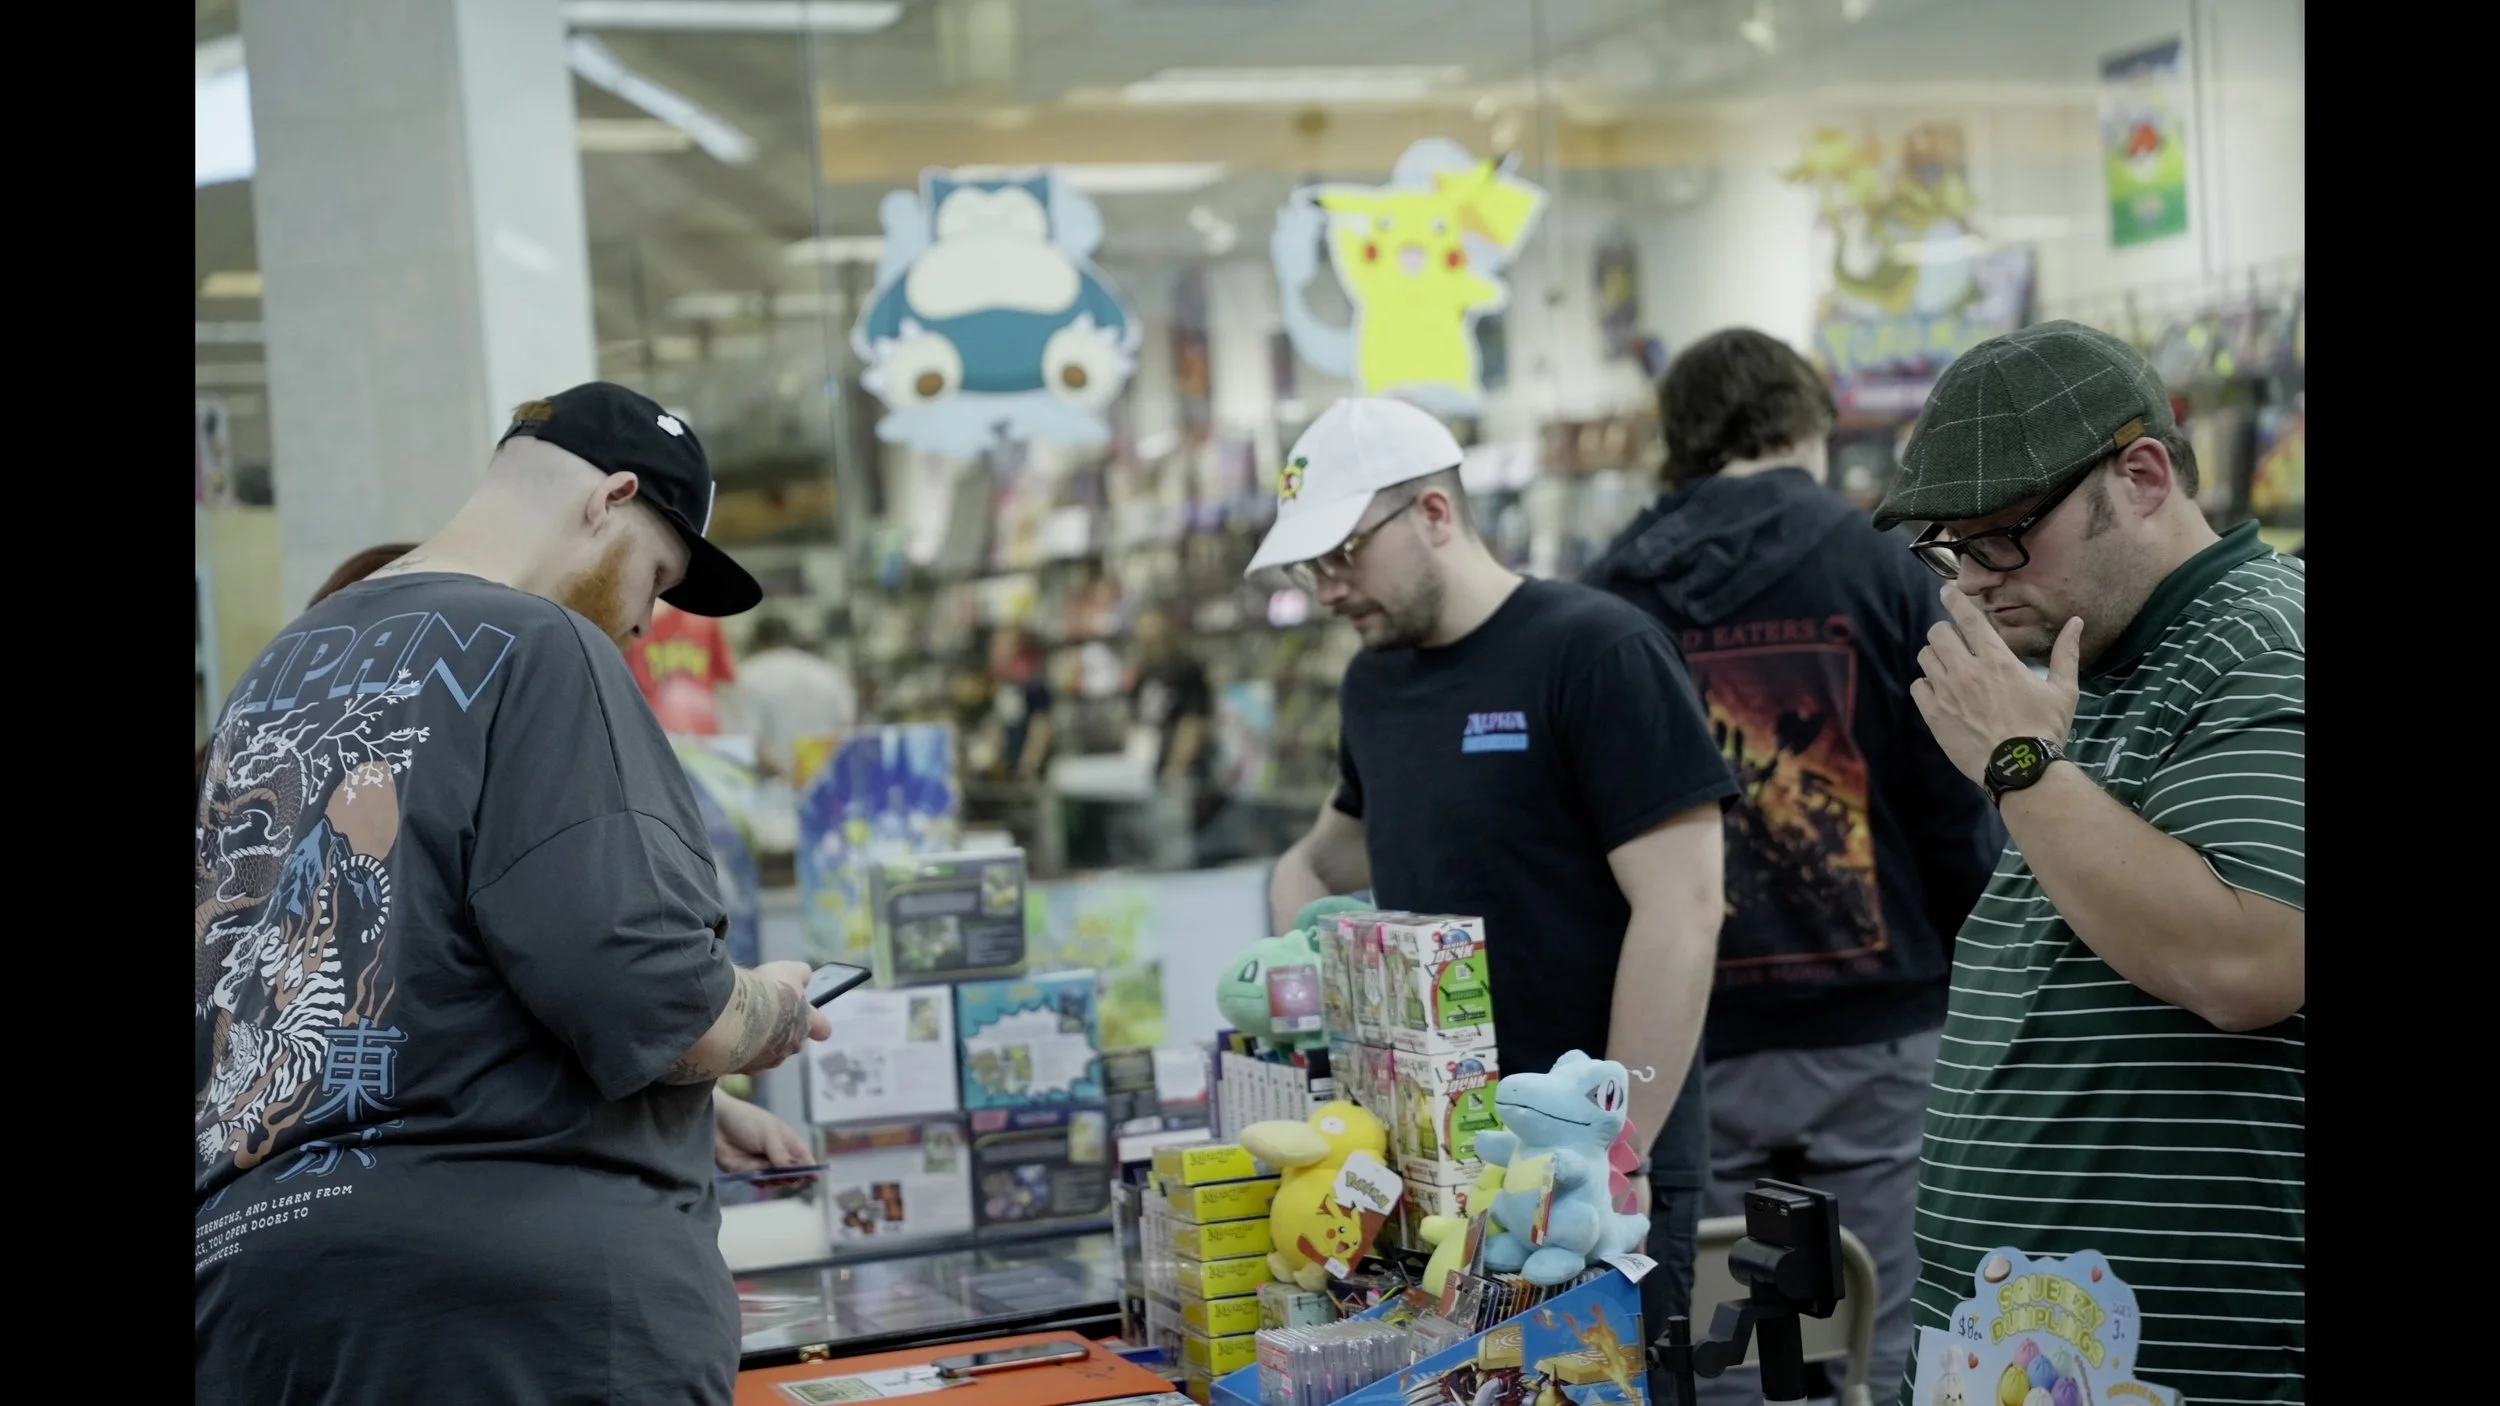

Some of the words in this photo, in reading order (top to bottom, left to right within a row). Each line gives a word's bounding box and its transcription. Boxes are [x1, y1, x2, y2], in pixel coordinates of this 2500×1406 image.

[226, 611, 516, 713] APAN
[196, 1210, 243, 1238] STRENGTHS,
[245, 1201, 268, 1217] AND
[272, 1191, 311, 1209] LEARN
[316, 1184, 353, 1199] FROM
[225, 1223, 247, 1241] OPEN
[251, 1212, 289, 1231] DOORS
[293, 1206, 309, 1220] TO
